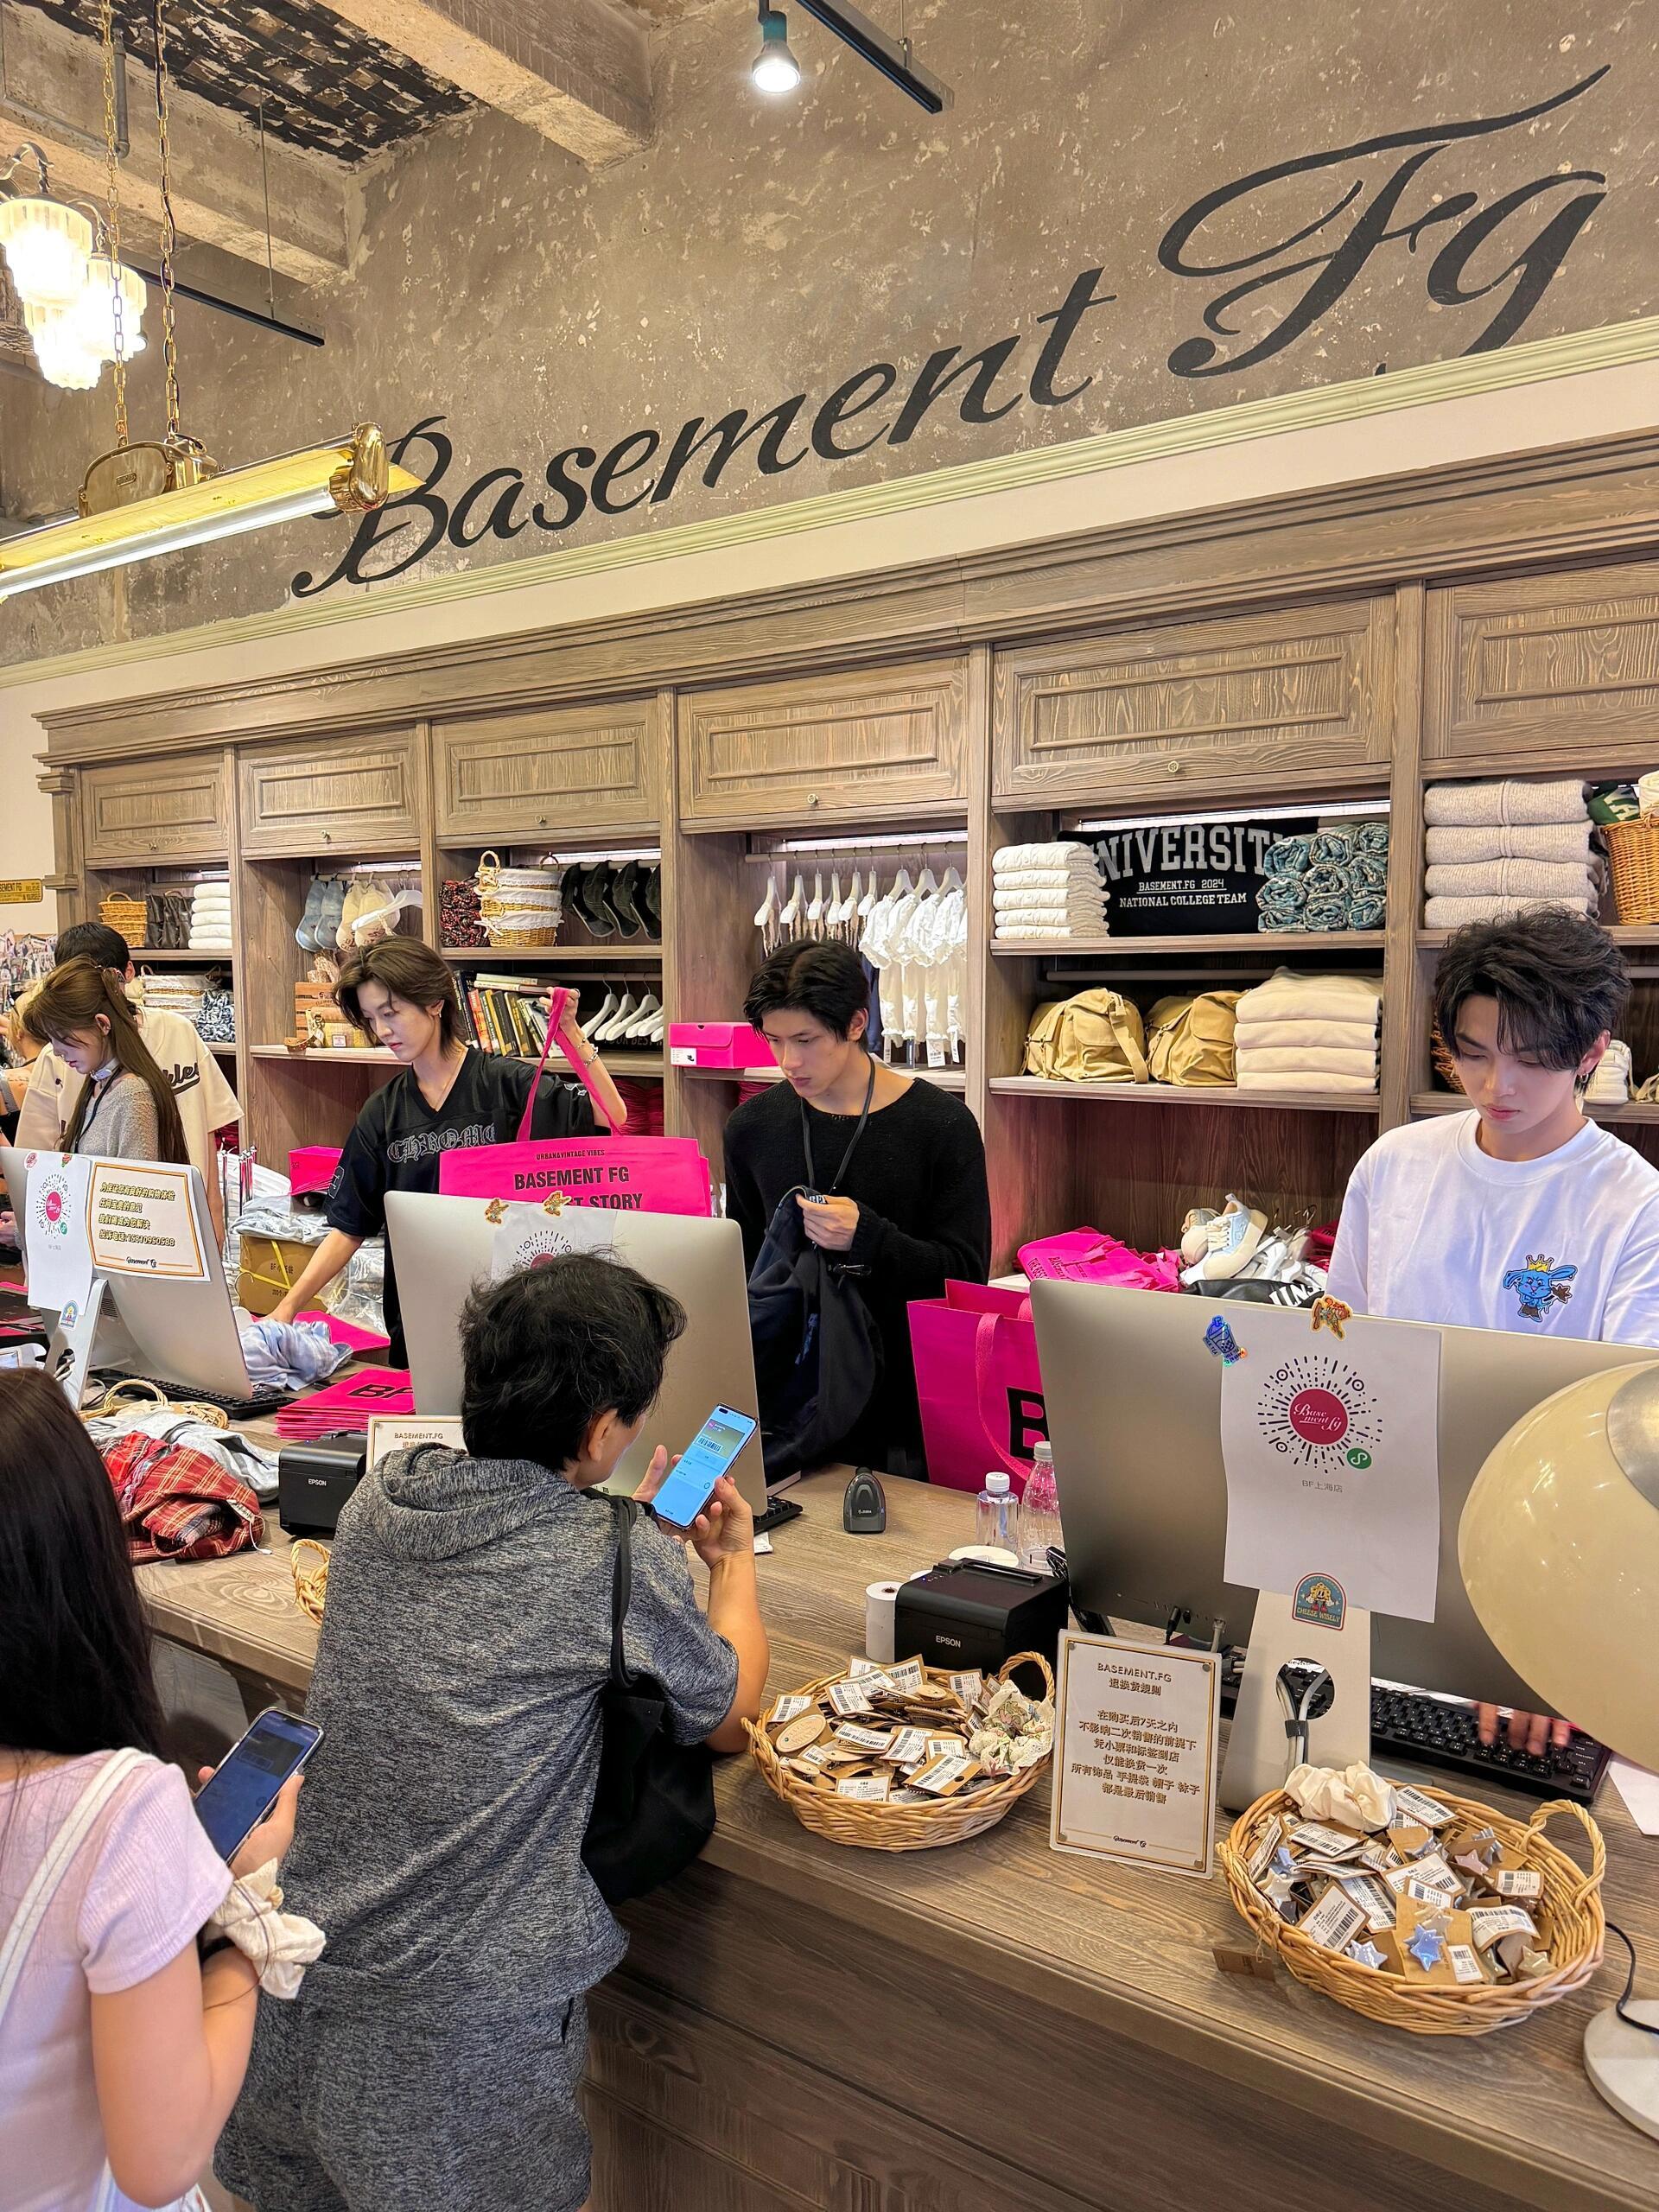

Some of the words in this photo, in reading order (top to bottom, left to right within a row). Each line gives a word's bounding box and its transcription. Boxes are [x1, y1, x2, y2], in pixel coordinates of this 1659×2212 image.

[292, 266, 1117, 597] Basement
[1156, 63, 1610, 377] Fg
[1089, 824, 1284, 881] NIVERSIT
[1138, 880, 1196, 892] BASEMENT.FG
[1201, 878, 1224, 889] 2024
[1119, 896, 1169, 907] NATIONAL
[1170, 894, 1215, 906] COLLEGE
[1217, 893, 1247, 904] TEAM
[536, 1150, 586, 1160] URBAN&VINTAGE
[514, 1167, 604, 1191] BASEMENT
[608, 1166, 630, 1183] FG
[308, 1478, 327, 1487] EPSON
[935, 1635, 961, 1649] EPSON
[1096, 1662, 1173, 1682] BASEMENT.FG
[1109, 1676, 1162, 1696] 退换货规则
[1097, 1709, 1179, 1733] 在购买后7天之内
[1078, 1720, 1198, 1751] 不影响二次销售的前提下
[1092, 1738, 1180, 1763] 凭小票和标签到店
[1103, 1754, 1168, 1776] 仅能换货一次
[1071, 1763, 1113, 1781] 所有饰品
[1116, 1771, 1150, 1788] 手提袋
[1152, 1777, 1175, 1791] 帽子
[1177, 1781, 1201, 1796] 袜子
[1101, 1782, 1167, 1805] 都是最后销售
